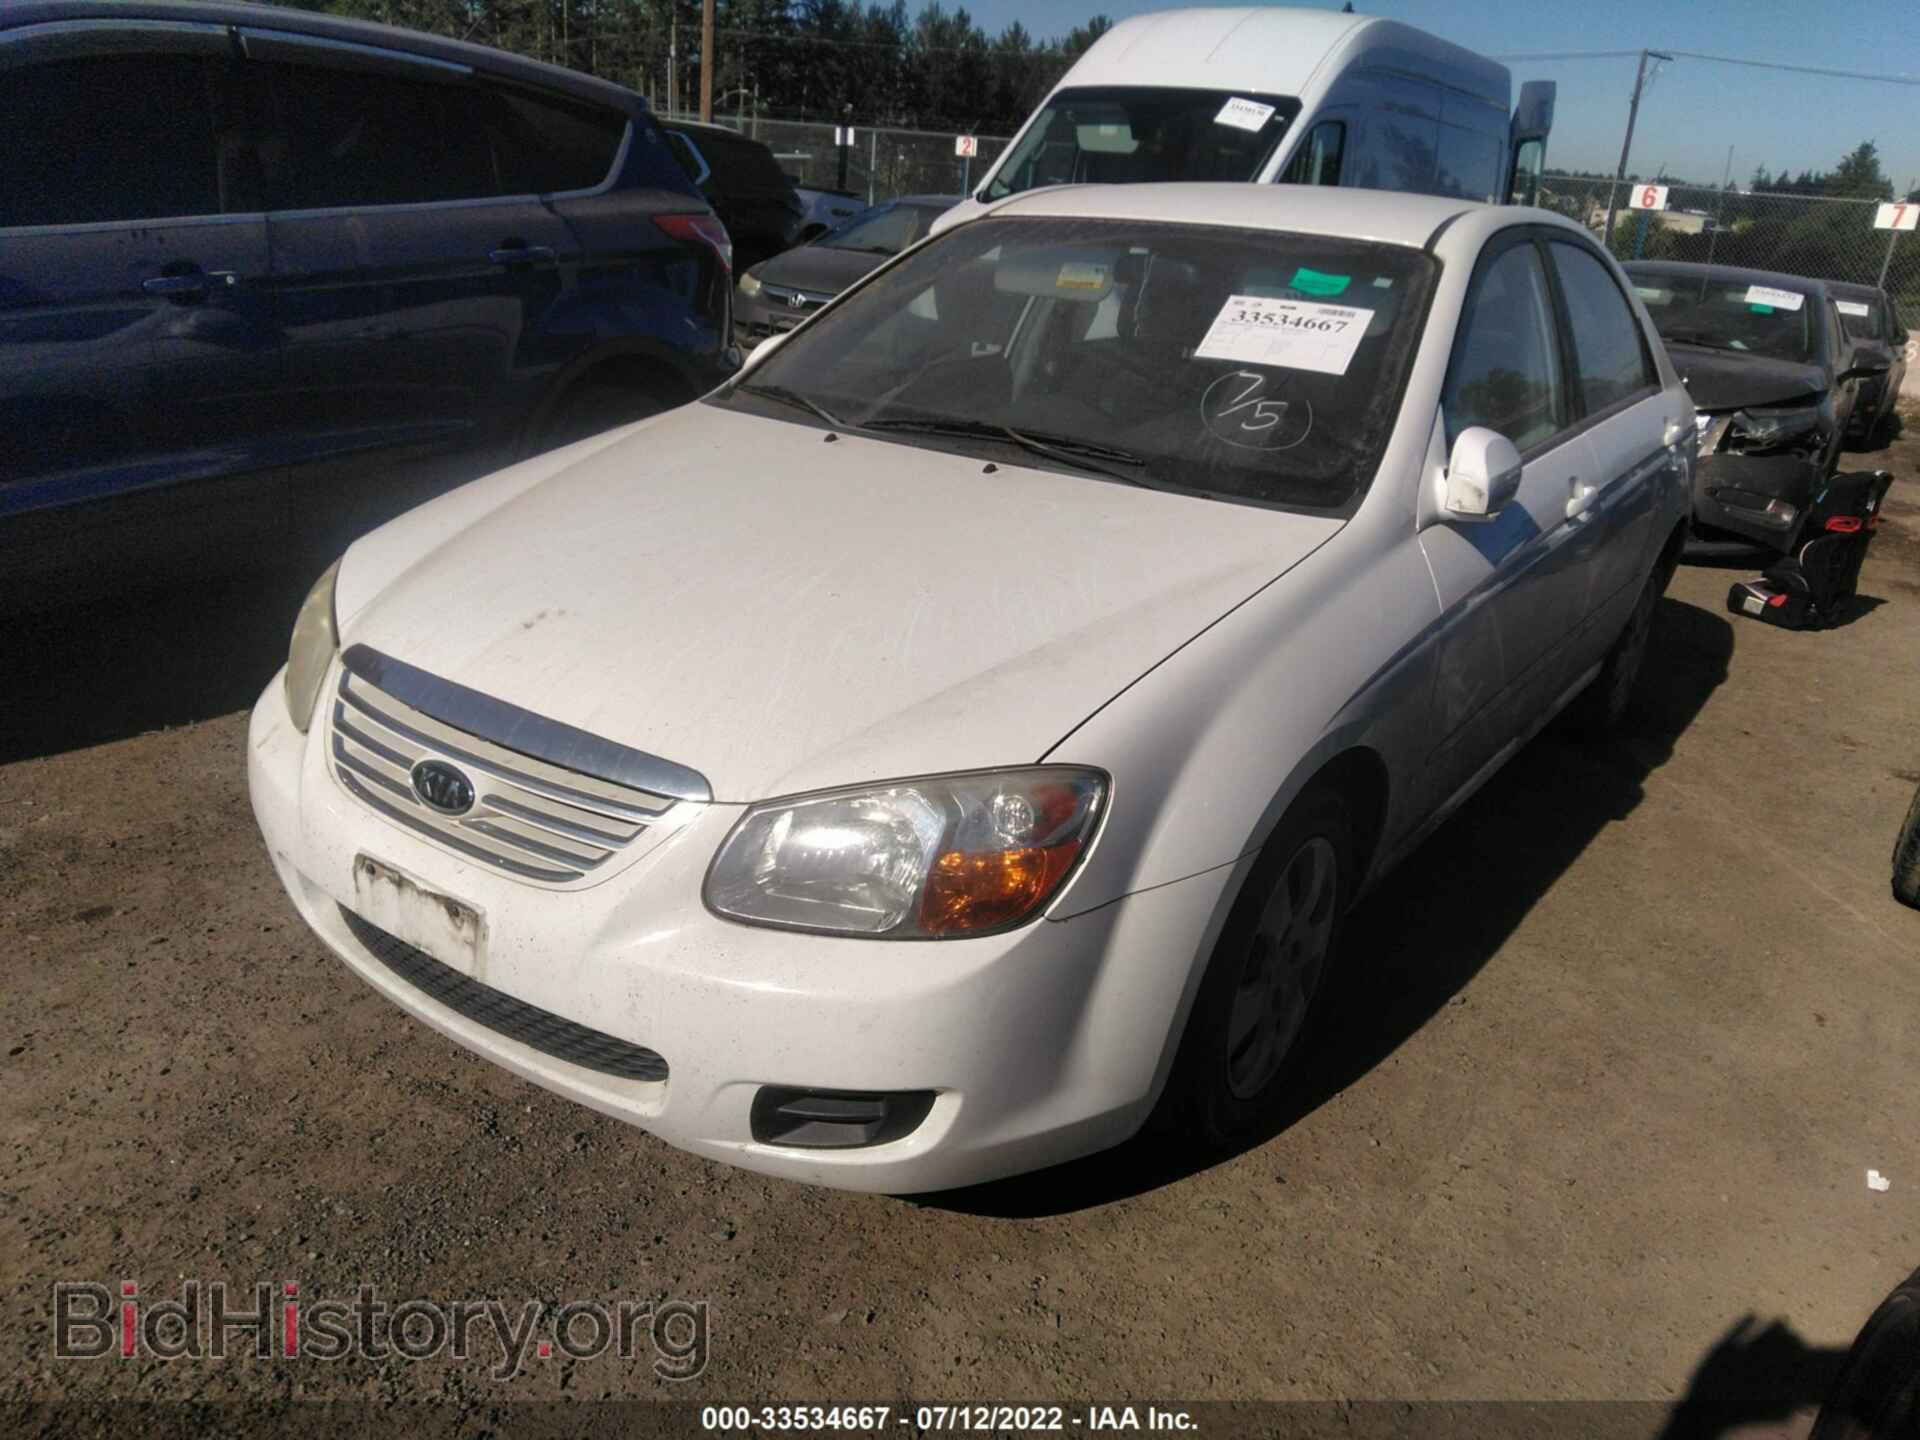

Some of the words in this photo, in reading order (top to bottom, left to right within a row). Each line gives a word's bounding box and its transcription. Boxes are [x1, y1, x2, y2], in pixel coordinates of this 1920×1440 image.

[961, 138, 972, 155] 2
[1641, 186, 1657, 208] 6
[1891, 202, 1907, 228] 7
[1231, 309, 1350, 333] 33534667
